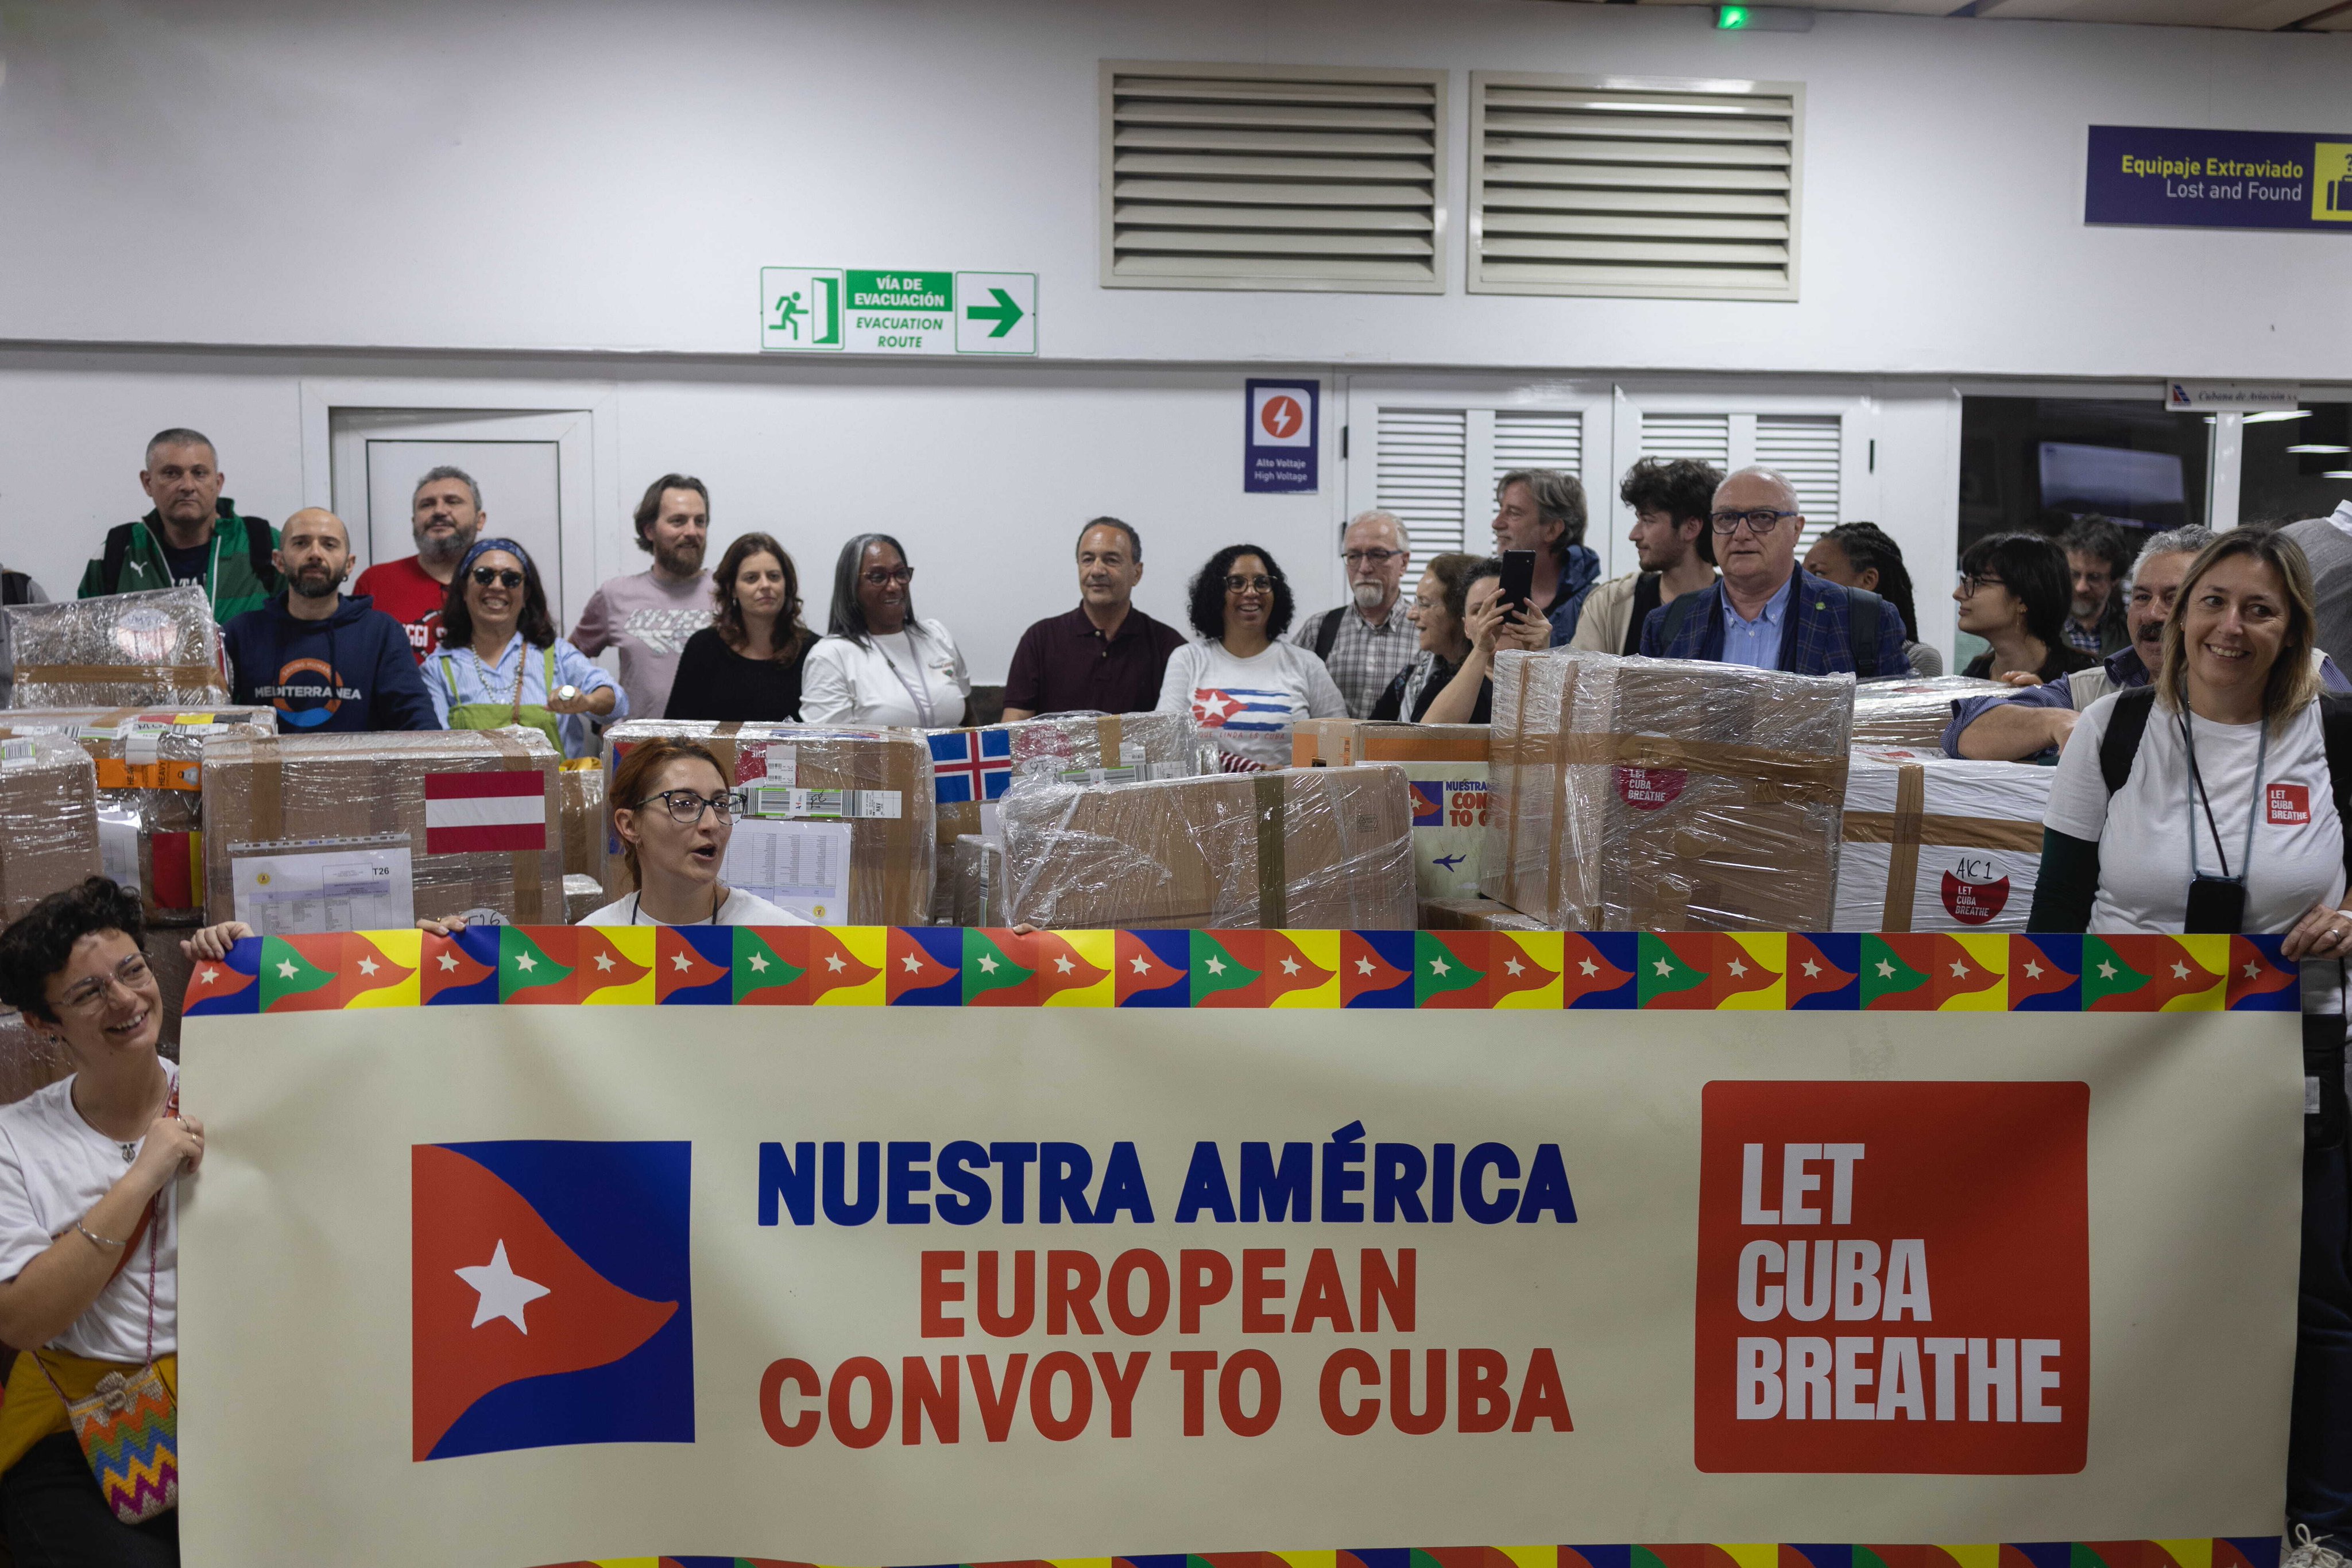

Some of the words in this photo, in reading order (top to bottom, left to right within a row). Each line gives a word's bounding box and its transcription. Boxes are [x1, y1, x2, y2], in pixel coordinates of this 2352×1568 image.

[2122, 154, 2201, 179] Equipaje
[2207, 157, 2303, 179] Extraviado
[2167, 179, 2204, 199] Lost
[2209, 181, 2241, 200] and
[2248, 181, 2302, 201] Found
[876, 275, 900, 290] VÍA
[903, 278, 922, 291] DE
[854, 291, 945, 307] EVACUACIÓN
[856, 316, 943, 331] EVACUATION
[877, 335, 922, 348] ROUTE
[1256, 459, 1275, 467] Alto
[1277, 459, 1306, 470] Voltaje
[1254, 471, 1274, 482] High
[1276, 472, 1307, 482] Voltage
[255, 685, 362, 700] MEDITERRANEA
[158, 761, 166, 786] HEAVY
[1630, 769, 1646, 778] LET
[1446, 781, 1487, 791] NUESTRA
[1629, 779, 1651, 789] CUBA
[1452, 792, 1488, 810] CON
[1628, 789, 1666, 802] BREATHE
[2271, 790, 2285, 799] LET
[2271, 800, 2293, 810] CUBA
[1449, 810, 1473, 827] TO
[2271, 810, 2308, 820] BREATHE
[373, 867, 389, 876] T26
[1958, 886, 1972, 895] LET
[1956, 896, 1976, 905] CUBA
[1955, 905, 1989, 916] BREATHE
[756, 1140, 1155, 1226] NUESTRA
[1174, 1120, 1579, 1225] AMÉRICA
[1741, 1143, 1865, 1225] LET
[1737, 1238, 1933, 1322] CUBA
[920, 1248, 1417, 1338] EUROPEAN
[1736, 1337, 2062, 1423] BREATHE
[759, 1350, 1151, 1449] CONVOY
[1170, 1350, 1282, 1437] TO
[1318, 1347, 1575, 1437] CUBA
